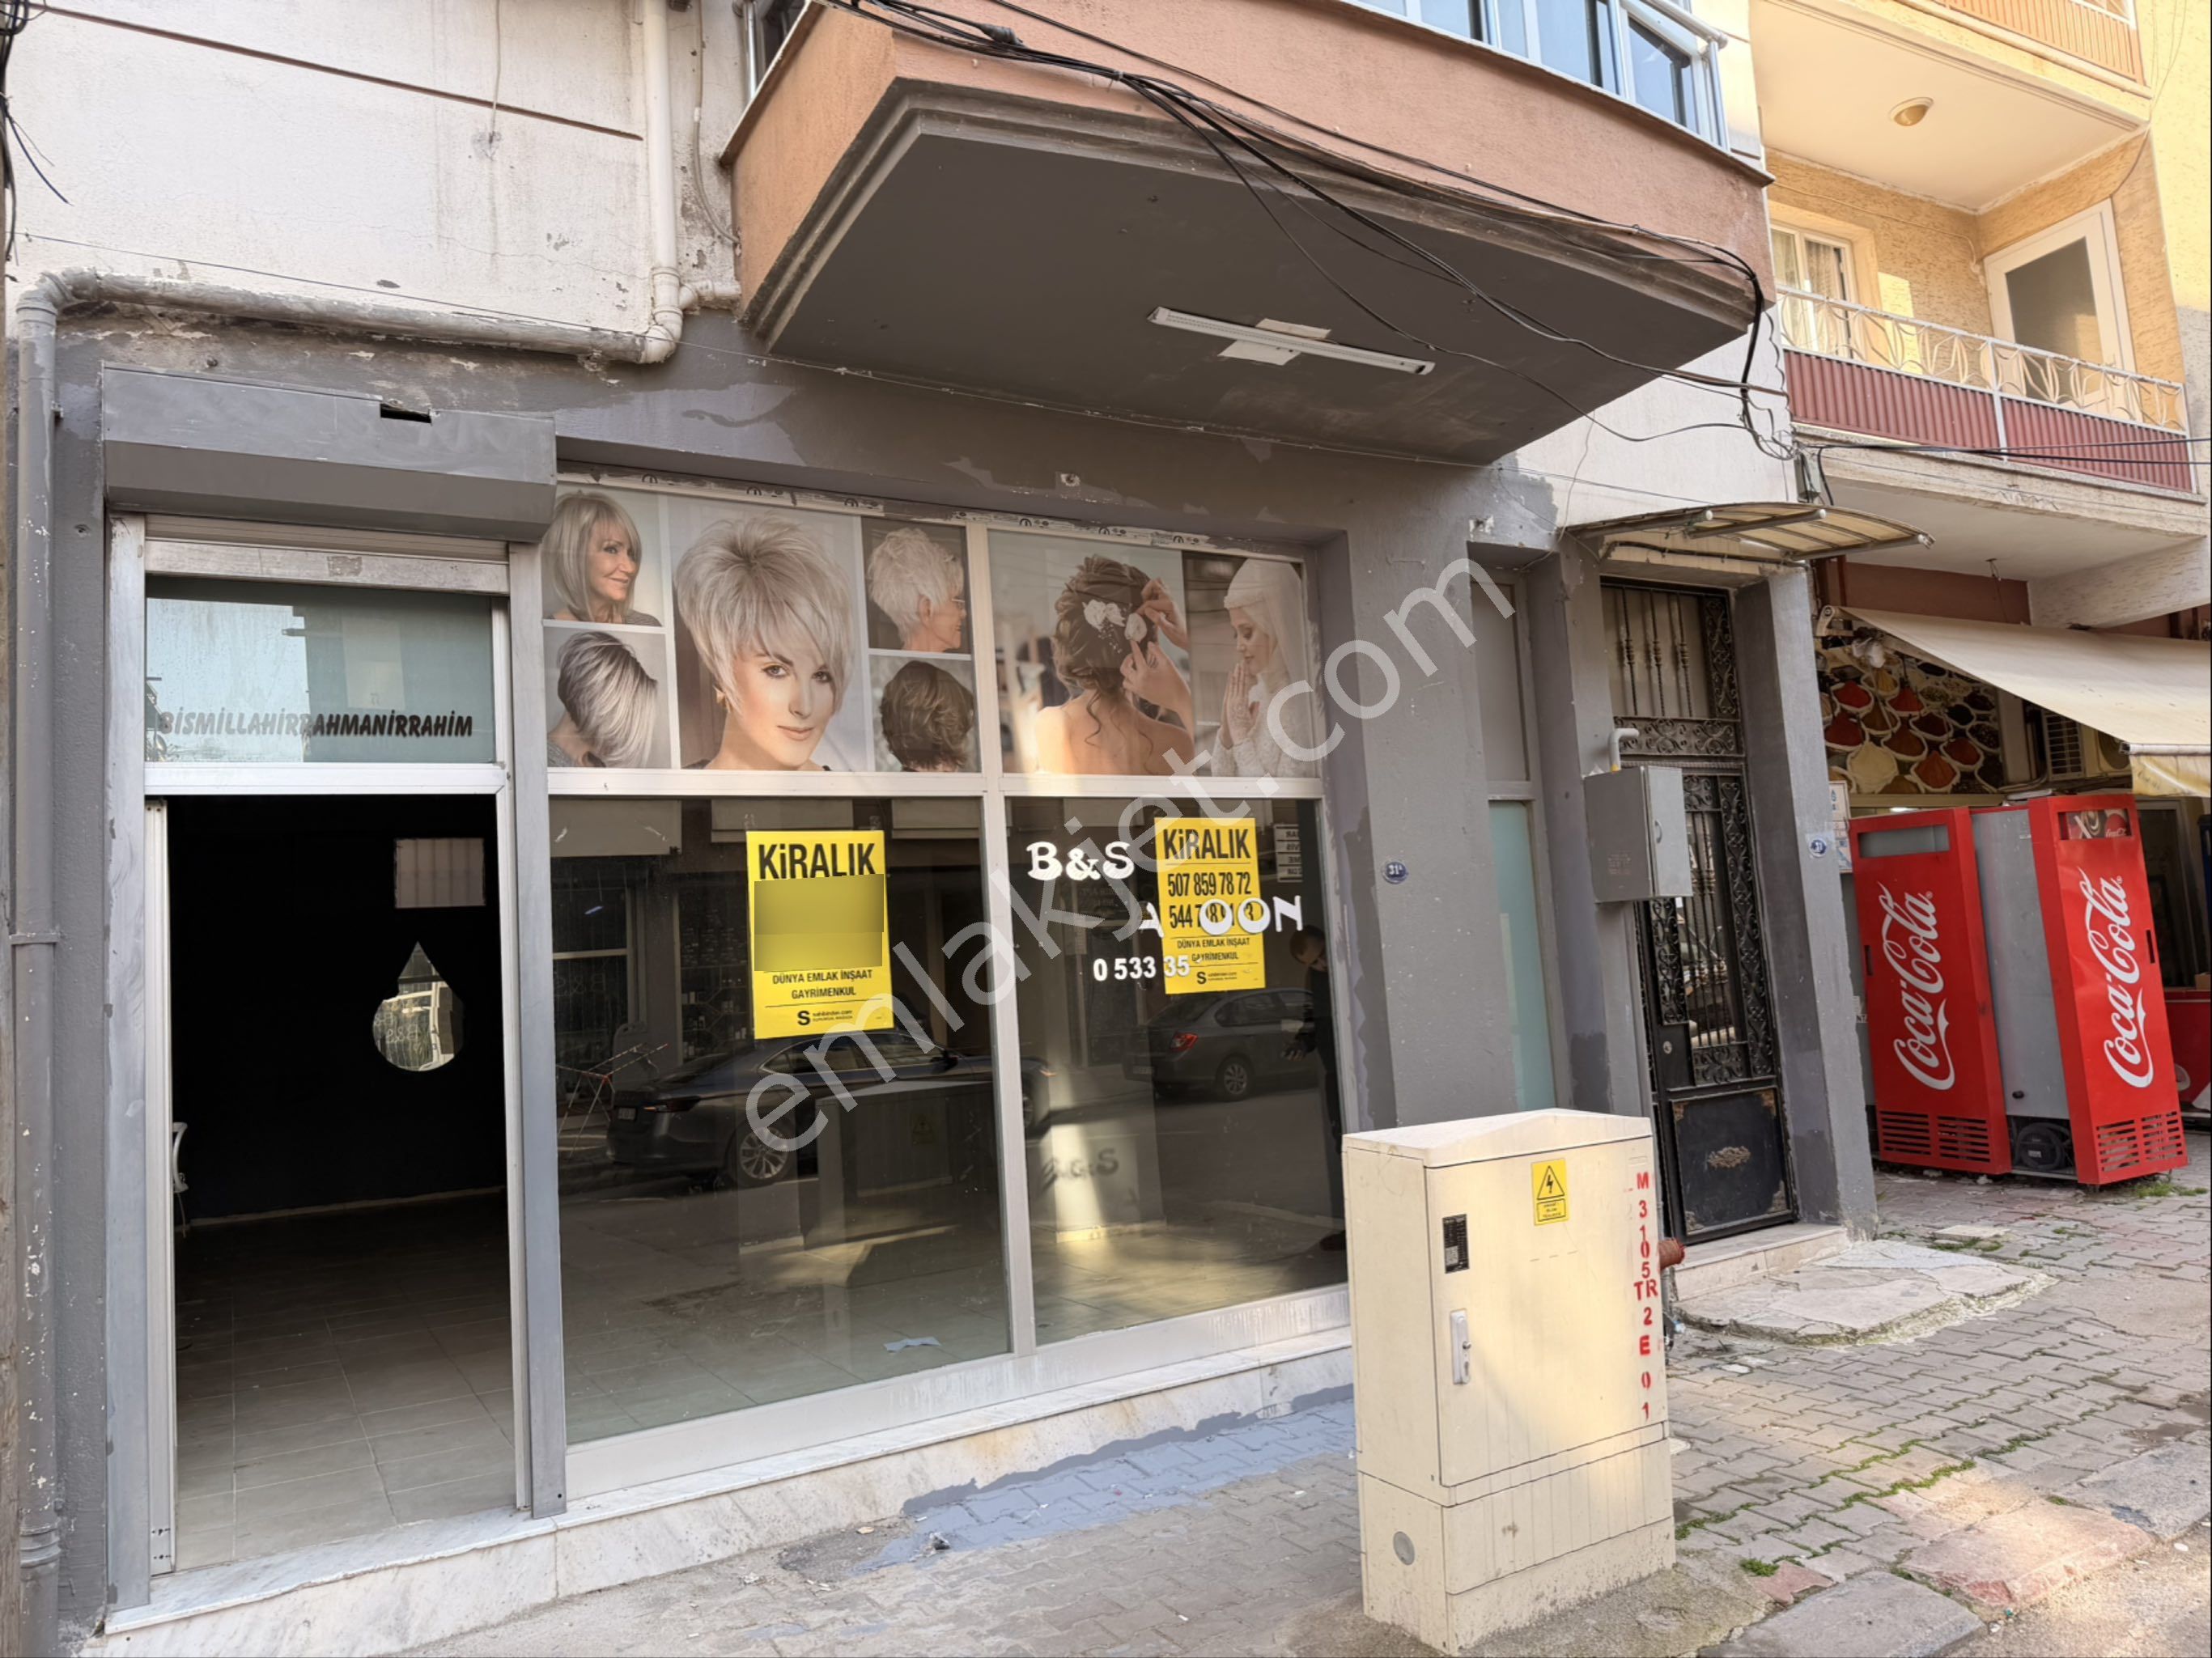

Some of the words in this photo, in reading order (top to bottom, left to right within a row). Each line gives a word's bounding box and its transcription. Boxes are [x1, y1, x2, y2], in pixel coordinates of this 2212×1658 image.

[1026, 841, 1135, 881] B&S
[1167, 872, 1190, 897] 507
[1194, 872, 1216, 897] 859
[1219, 871, 1234, 895] 78
[1236, 871, 1251, 895] 72
[1169, 904, 1192, 928] 544
[1177, 939, 1201, 948] DÜNYA
[1203, 939, 1225, 948] EMLAK
[772, 973, 805, 985] DÜNYA
[807, 971, 839, 982] EMLAK
[841, 969, 873, 982] İNŞAAT
[1093, 958, 1107, 982] 0
[1114, 956, 1156, 980] 533
[1163, 955, 1190, 977] 35
[1197, 971, 1207, 985] S
[2078, 866, 2154, 1088] Coca-Cola
[792, 986, 856, 999] GAYRİMENKUL
[1878, 881, 1955, 1090] Coca-Cola
[797, 1010, 811, 1025] S
